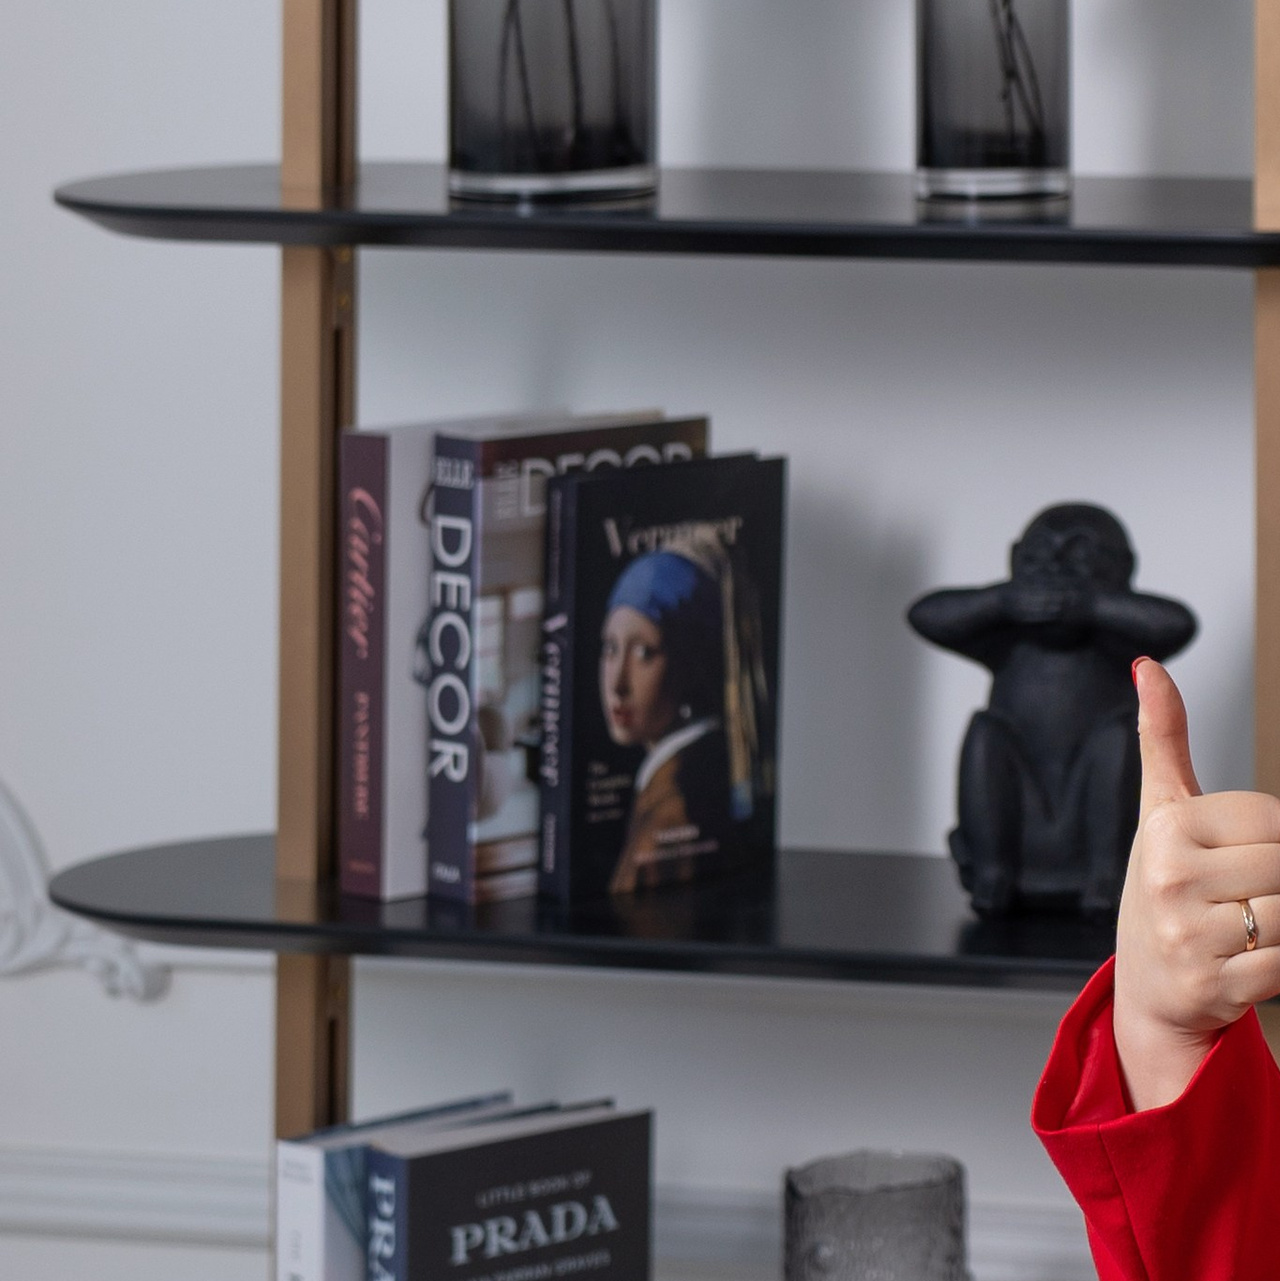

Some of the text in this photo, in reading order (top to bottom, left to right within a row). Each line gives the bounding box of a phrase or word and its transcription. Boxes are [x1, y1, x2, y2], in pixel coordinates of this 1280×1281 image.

[347, 486, 383, 660] Cartier
[428, 515, 473, 783] DECOR
[449, 1195, 619, 1266] PRADA
